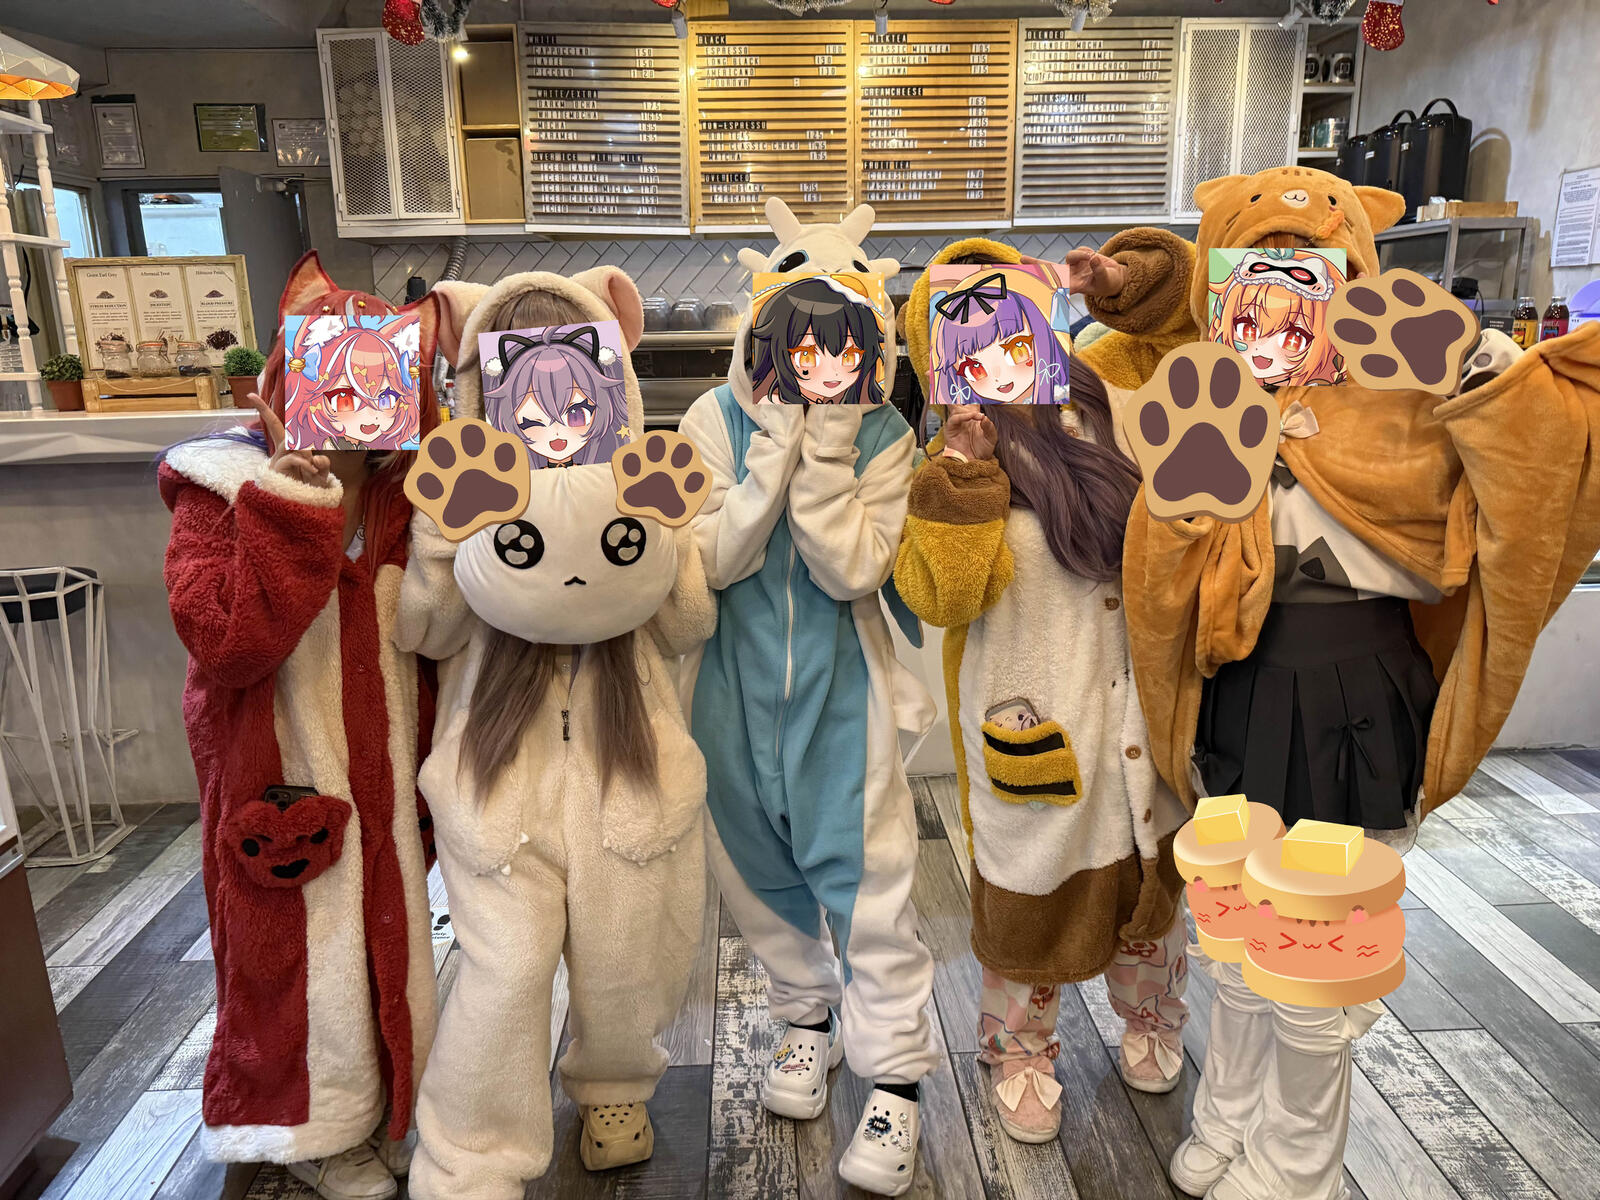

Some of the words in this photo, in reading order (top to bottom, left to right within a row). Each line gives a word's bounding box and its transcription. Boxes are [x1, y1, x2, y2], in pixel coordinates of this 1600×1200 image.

[1027, 30, 1065, 39] BLENDED
[528, 36, 556, 44] WHITE
[698, 35, 726, 44] BLACK
[1076, 41, 1102, 49] MOCHA
[534, 48, 589, 56] CAPPUCCINO
[637, 48, 652, 56] 150
[706, 47, 748, 55] ESPRESSO
[869, 46, 907, 54] CLASSIC
[1076, 51, 1112, 59] CARAMEL
[707, 57, 727, 65] LONG
[733, 57, 759, 65] BLACK
[707, 68, 755, 76] AMERICANO
[537, 90, 598, 98] WHITE/EXTRA
[864, 87, 922, 96] CREAMCHEESE
[533, 153, 556, 161] OVER
[561, 153, 577, 161] ICE
[590, 154, 612, 162] WITH
[620, 154, 643, 162] MILK
[864, 161, 890, 169] FRUIT
